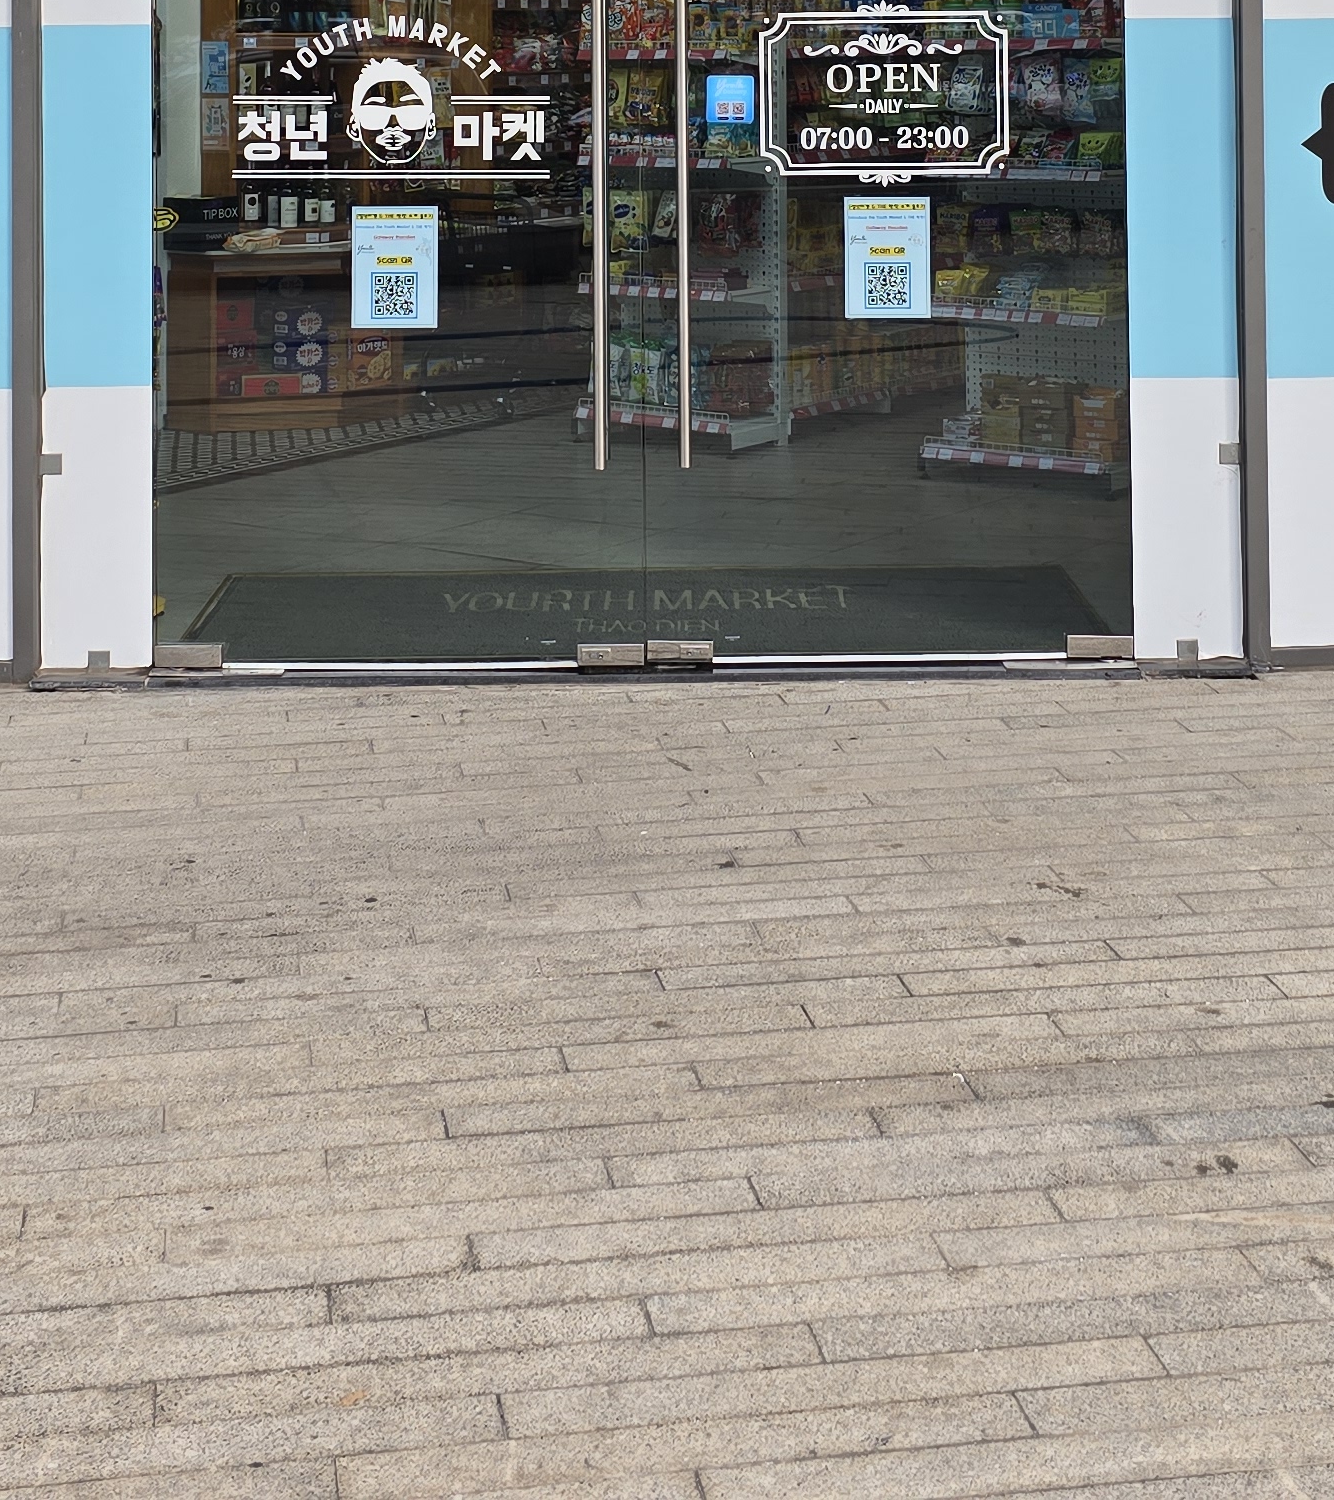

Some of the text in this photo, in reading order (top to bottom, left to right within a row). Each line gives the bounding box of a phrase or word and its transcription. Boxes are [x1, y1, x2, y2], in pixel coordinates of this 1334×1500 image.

[1034, 4, 1057, 12] CANDY
[280, 16, 502, 82] YOUTH MARKET
[826, 62, 940, 95] OPEN
[865, 98, 902, 115] DAILY
[237, 110, 544, 161] 청년 마켓
[800, 127, 873, 150] 07:00
[896, 126, 969, 150] 23:00
[203, 207, 238, 221] TIP BOX
[376, 256, 413, 264] Scan QR
[869, 247, 891, 255] Scan
[654, 585, 852, 611] MARKET
